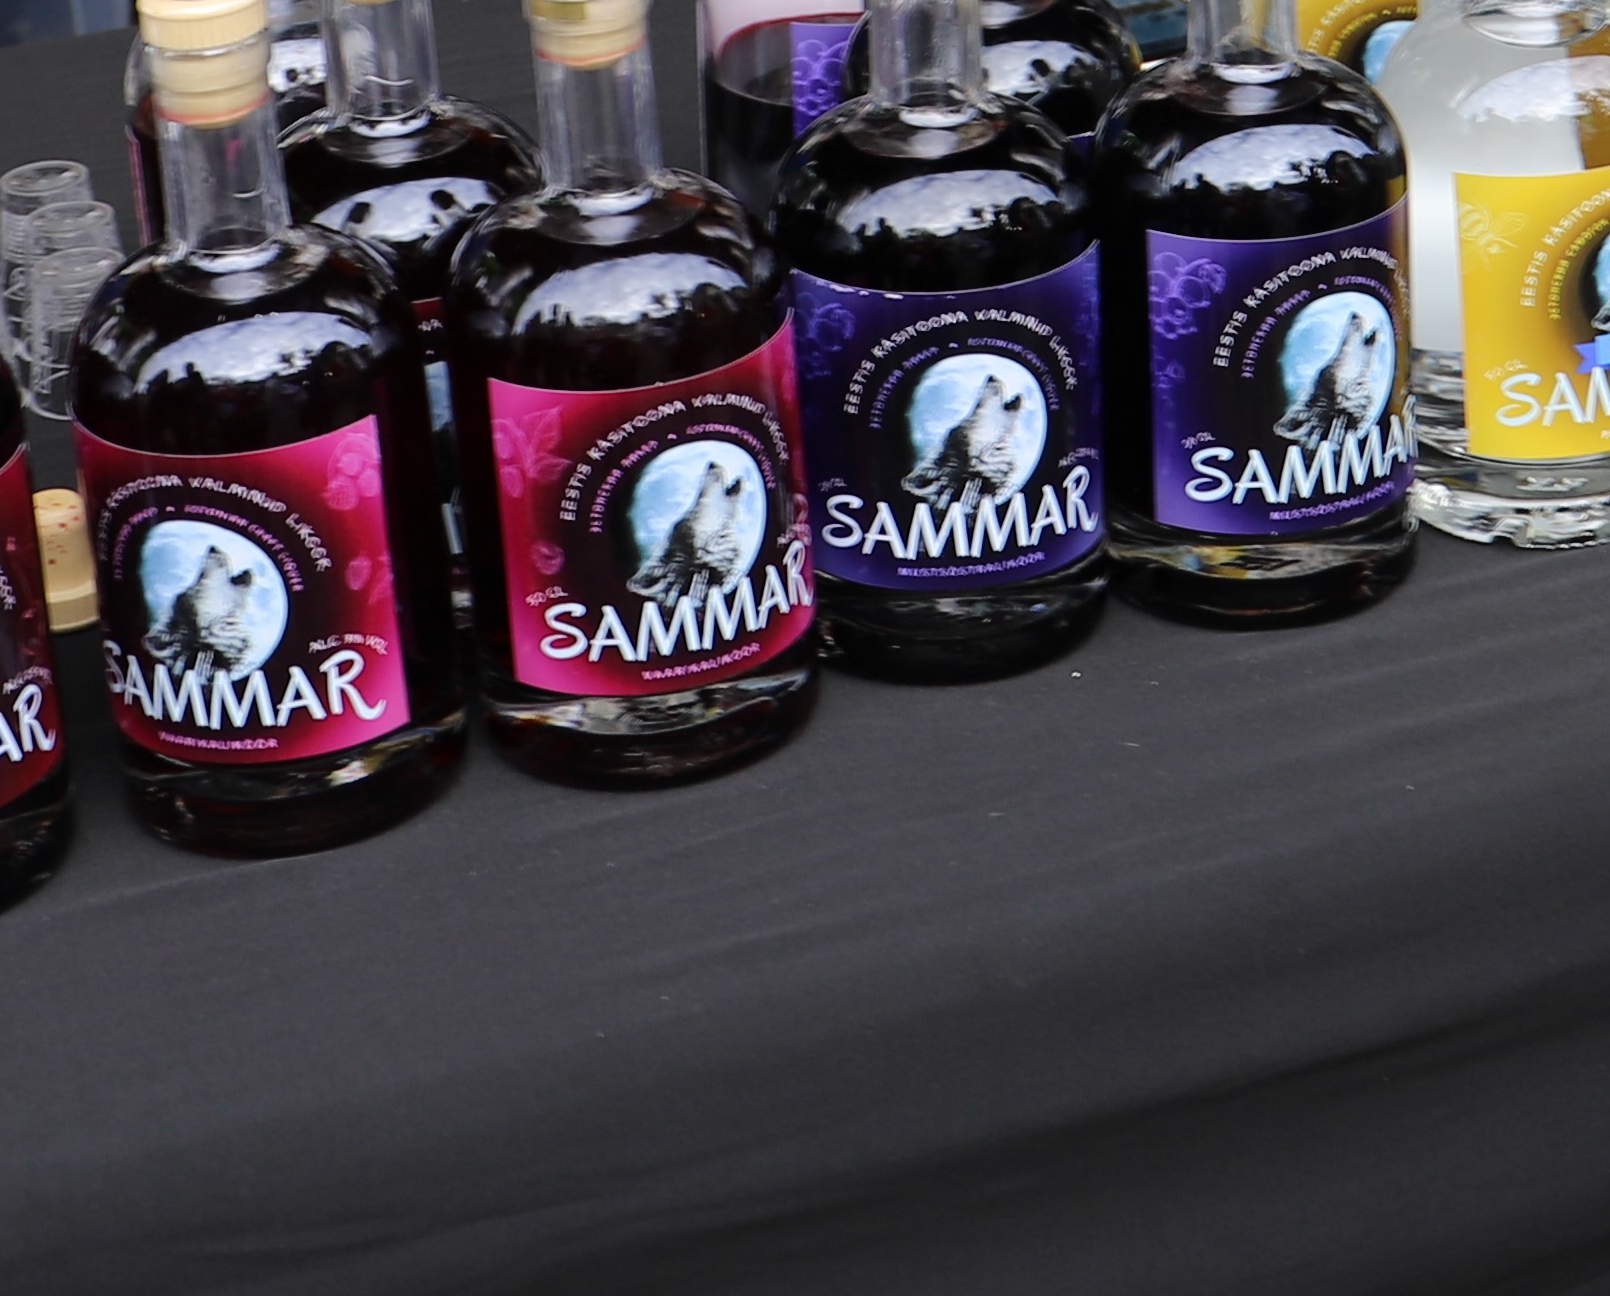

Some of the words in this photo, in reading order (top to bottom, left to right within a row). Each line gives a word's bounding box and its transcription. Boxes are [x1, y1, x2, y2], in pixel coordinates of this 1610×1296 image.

[1521, 251, 1547, 306] EESTIS
[1213, 311, 1248, 367] EESTIS
[843, 359, 876, 415] EESTIS
[188, 477, 286, 512] VALMINUD
[560, 463, 591, 521] EESTIS
[821, 465, 1098, 560] SAMMAR
[540, 539, 814, 662] SAMMAR
[104, 639, 386, 729] SAMMAR
